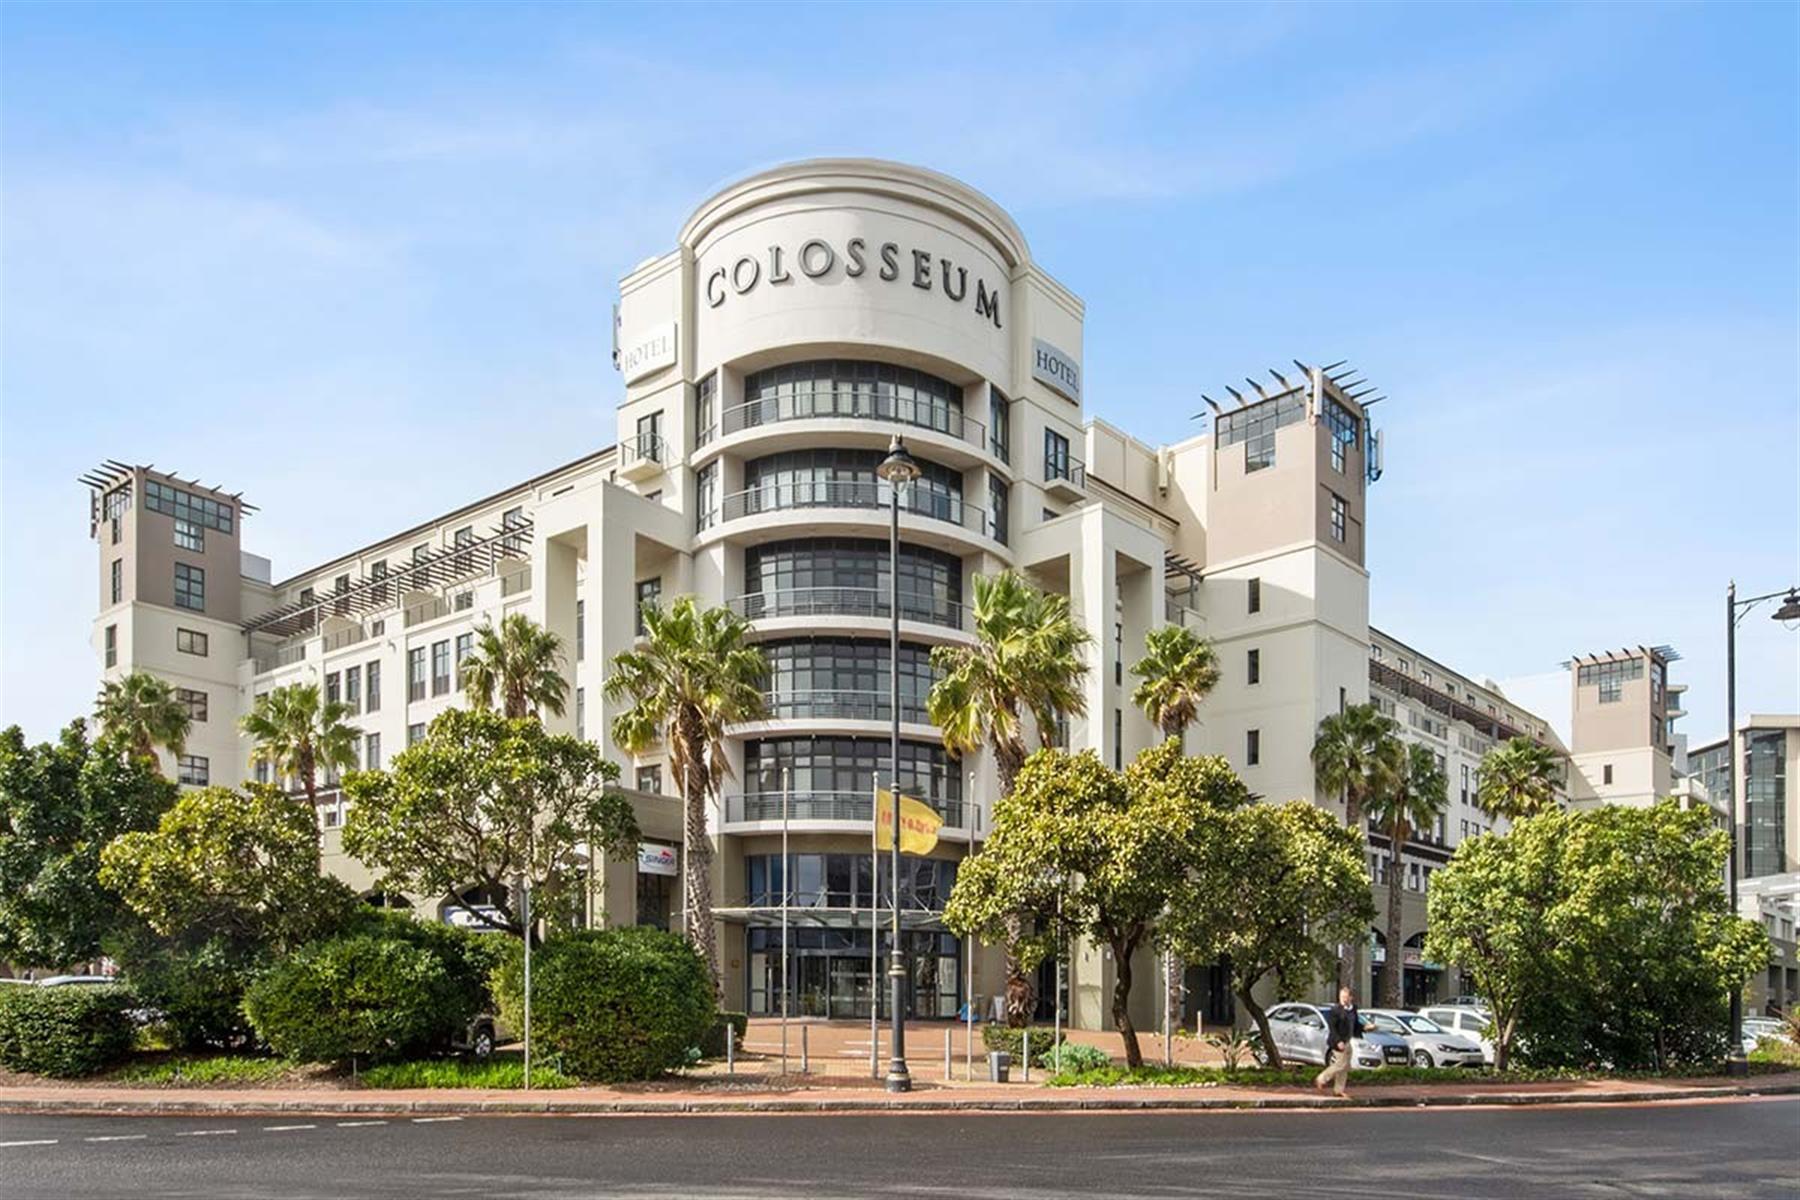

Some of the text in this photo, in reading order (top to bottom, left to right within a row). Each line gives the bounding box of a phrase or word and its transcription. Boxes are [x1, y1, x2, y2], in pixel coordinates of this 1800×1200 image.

[707, 238, 1002, 328] COLOSSEUM
[625, 335, 673, 373] HOTEL
[1036, 348, 1079, 393] HOTEL
